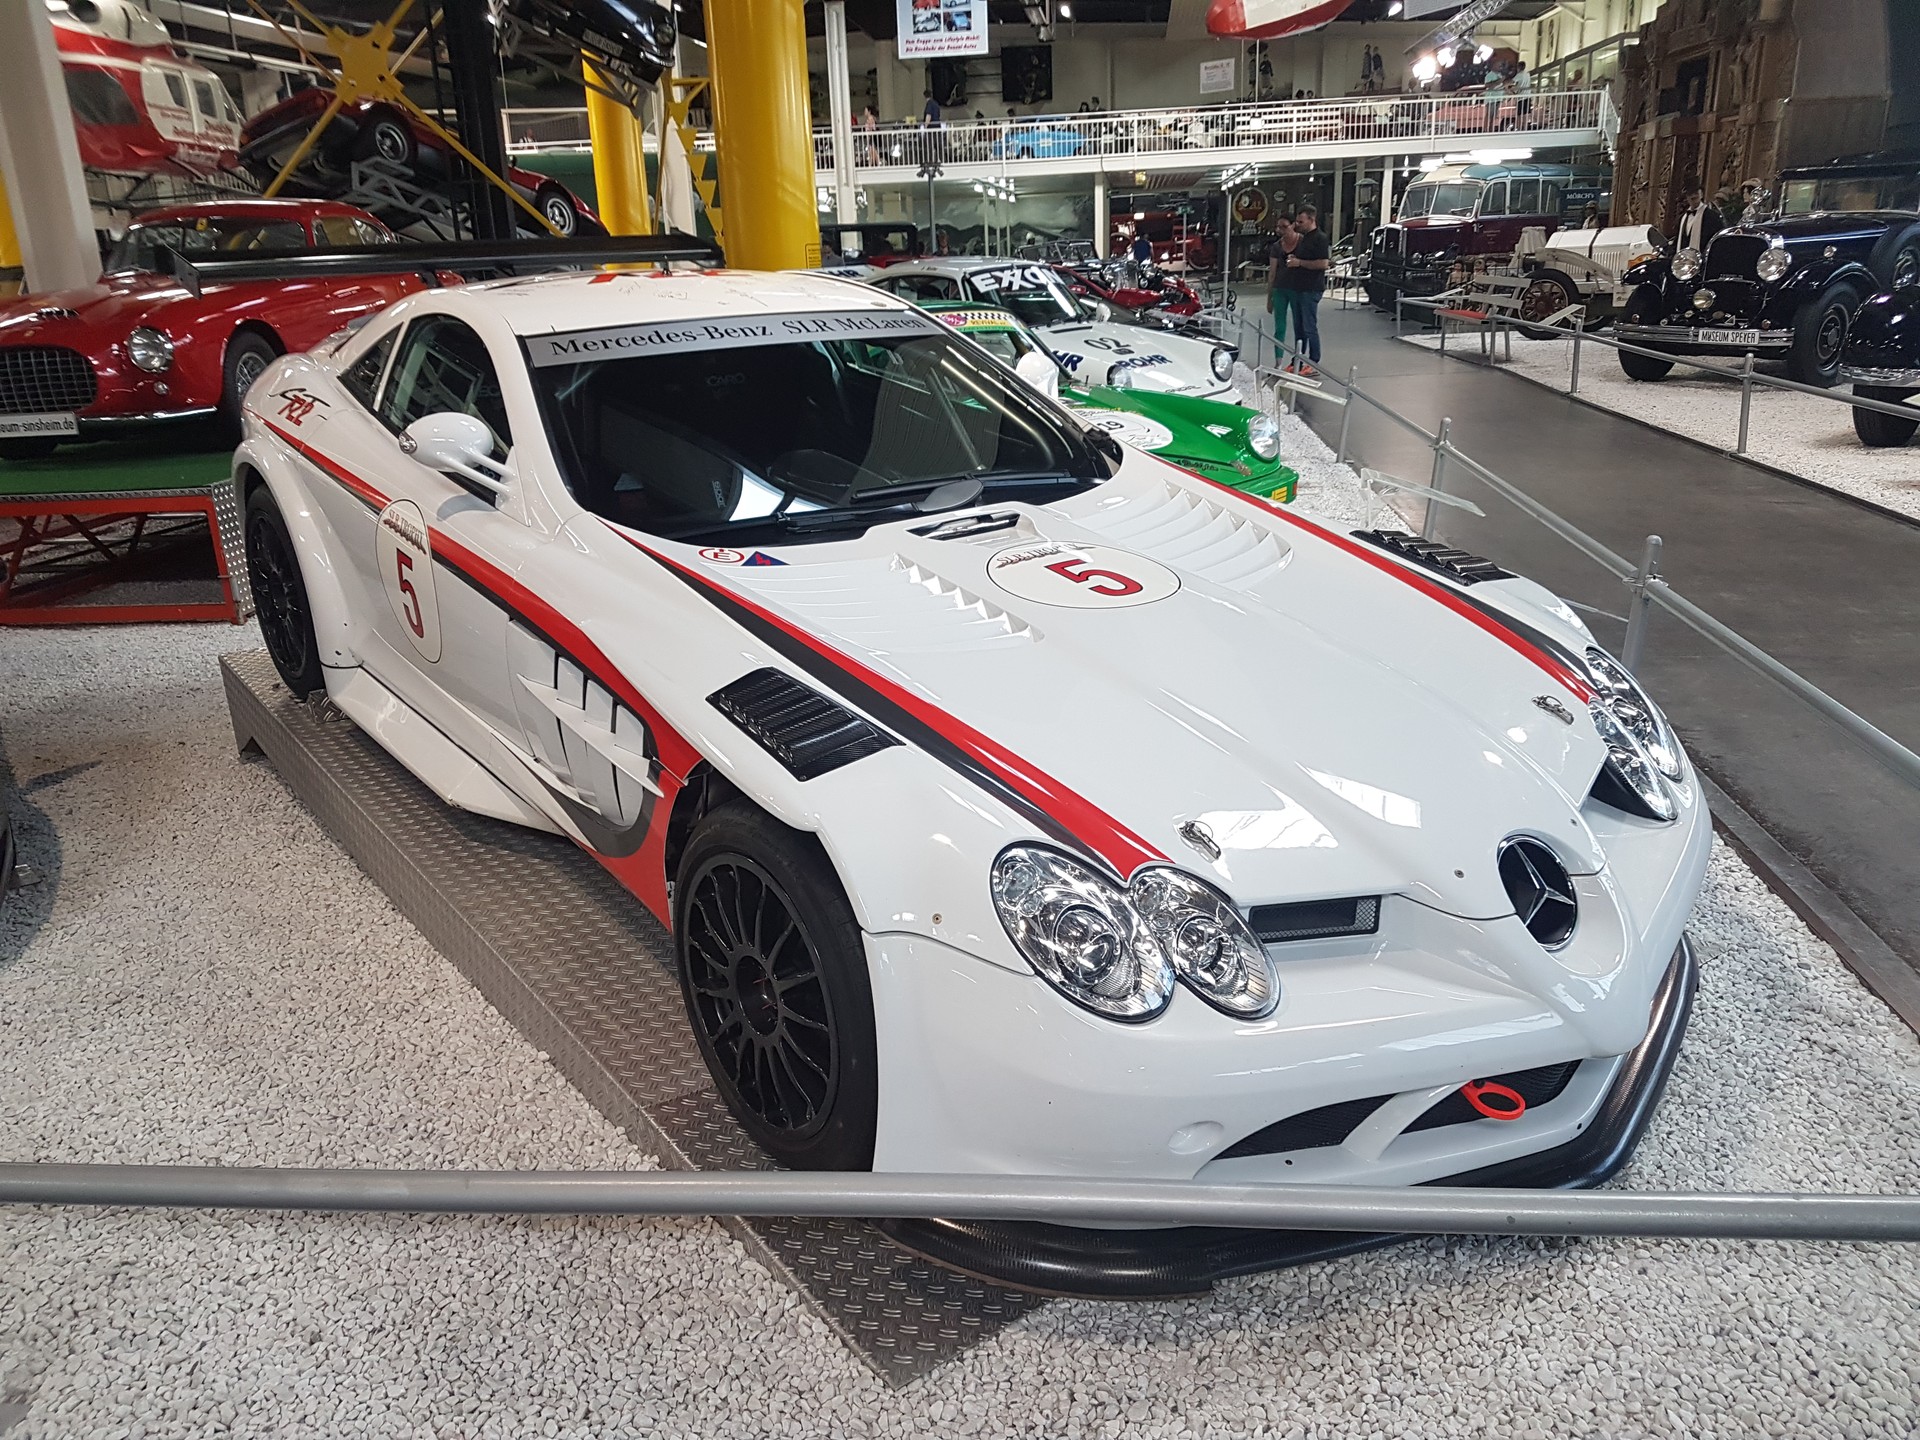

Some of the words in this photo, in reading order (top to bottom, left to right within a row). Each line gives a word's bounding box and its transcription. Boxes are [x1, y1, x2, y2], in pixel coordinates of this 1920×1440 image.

[549, 324, 774, 357] Mercedes-Benz
[781, 319, 832, 336] SLR
[833, 313, 926, 334] McLaren
[1083, 337, 1132, 351] 02
[1701, 330, 1730, 343] MUSEUM
[1730, 331, 1756, 344] SPEYER
[396, 547, 424, 638] 5
[1044, 559, 1144, 597] 5
